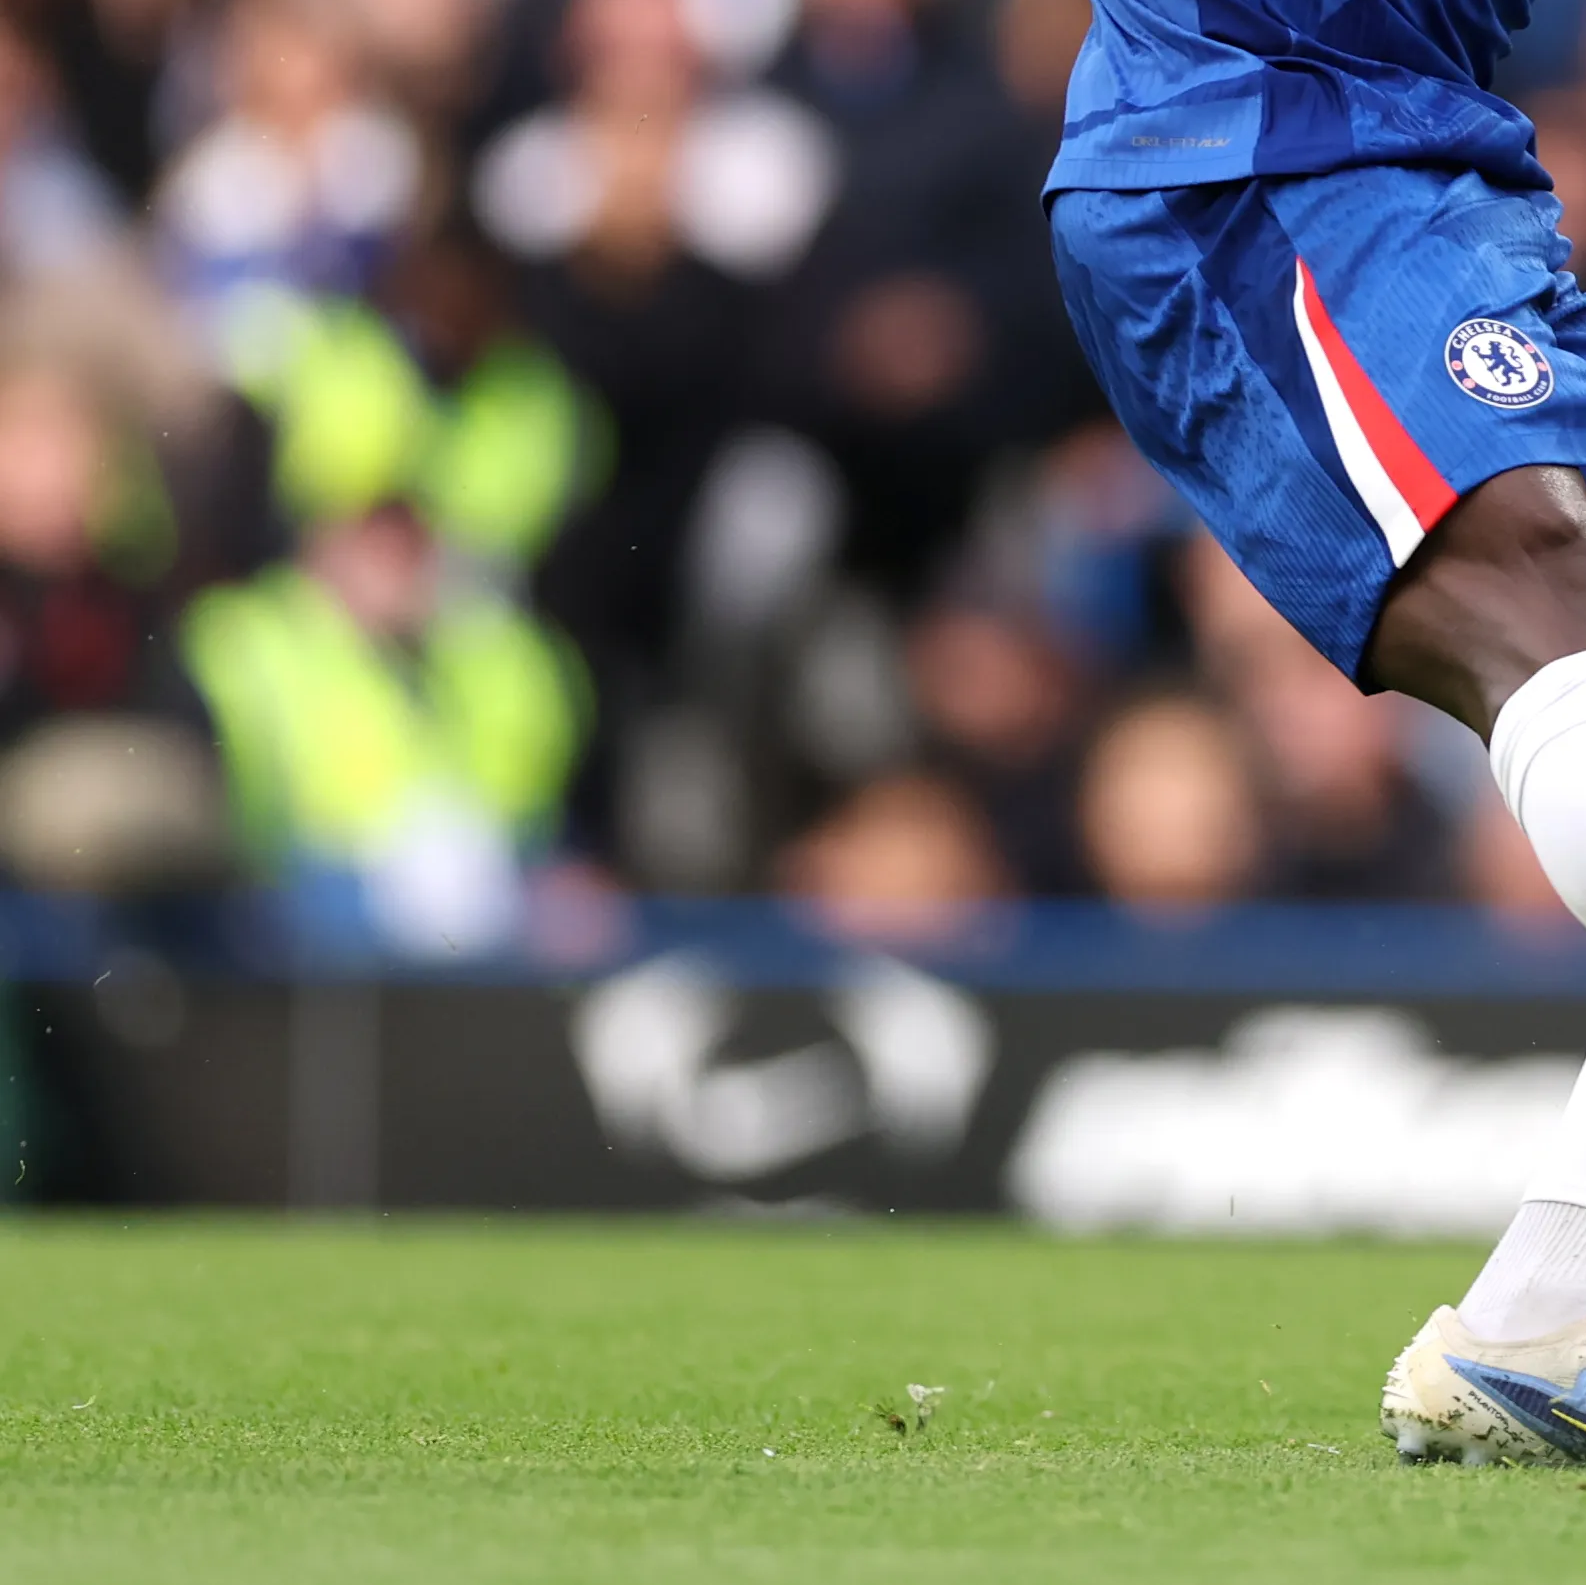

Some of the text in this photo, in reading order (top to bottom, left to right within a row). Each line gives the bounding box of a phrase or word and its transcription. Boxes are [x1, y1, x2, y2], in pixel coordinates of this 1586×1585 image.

[1452, 322, 1513, 349] CHELSEA
[1486, 380, 1548, 403] FOOTBALL CLUB
